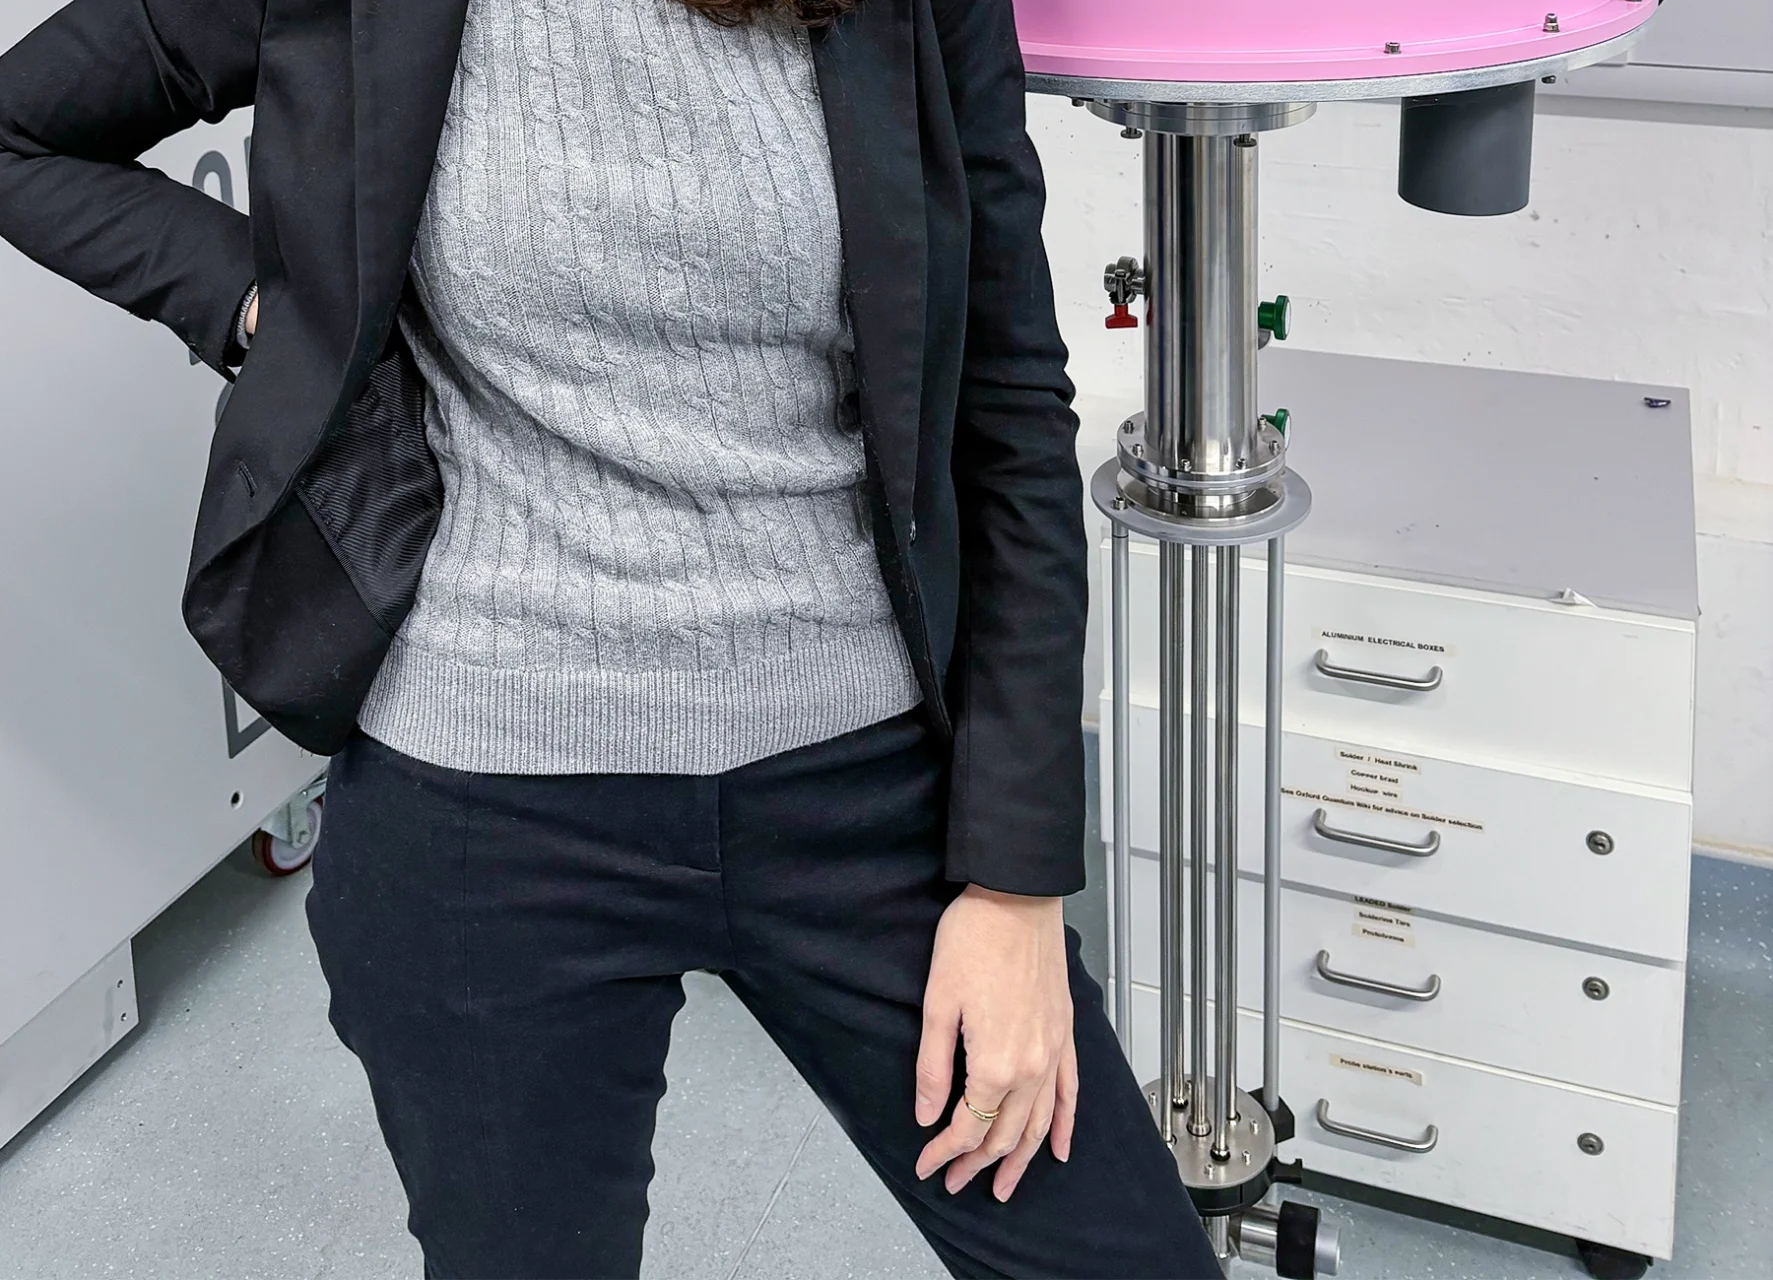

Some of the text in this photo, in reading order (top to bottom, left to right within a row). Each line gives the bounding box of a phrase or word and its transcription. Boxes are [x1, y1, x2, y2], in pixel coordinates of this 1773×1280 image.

[1321, 631, 1445, 652] ALUMINIUM ELECTRICAL BOXES
[1340, 751, 1364, 761] Solder
[1374, 757, 1392, 767] Heat
[1393, 760, 1418, 771] Shrink
[1295, 789, 1320, 800] Oxford
[1322, 794, 1355, 806] Quantum
[1354, 895, 1386, 907] LEADED
